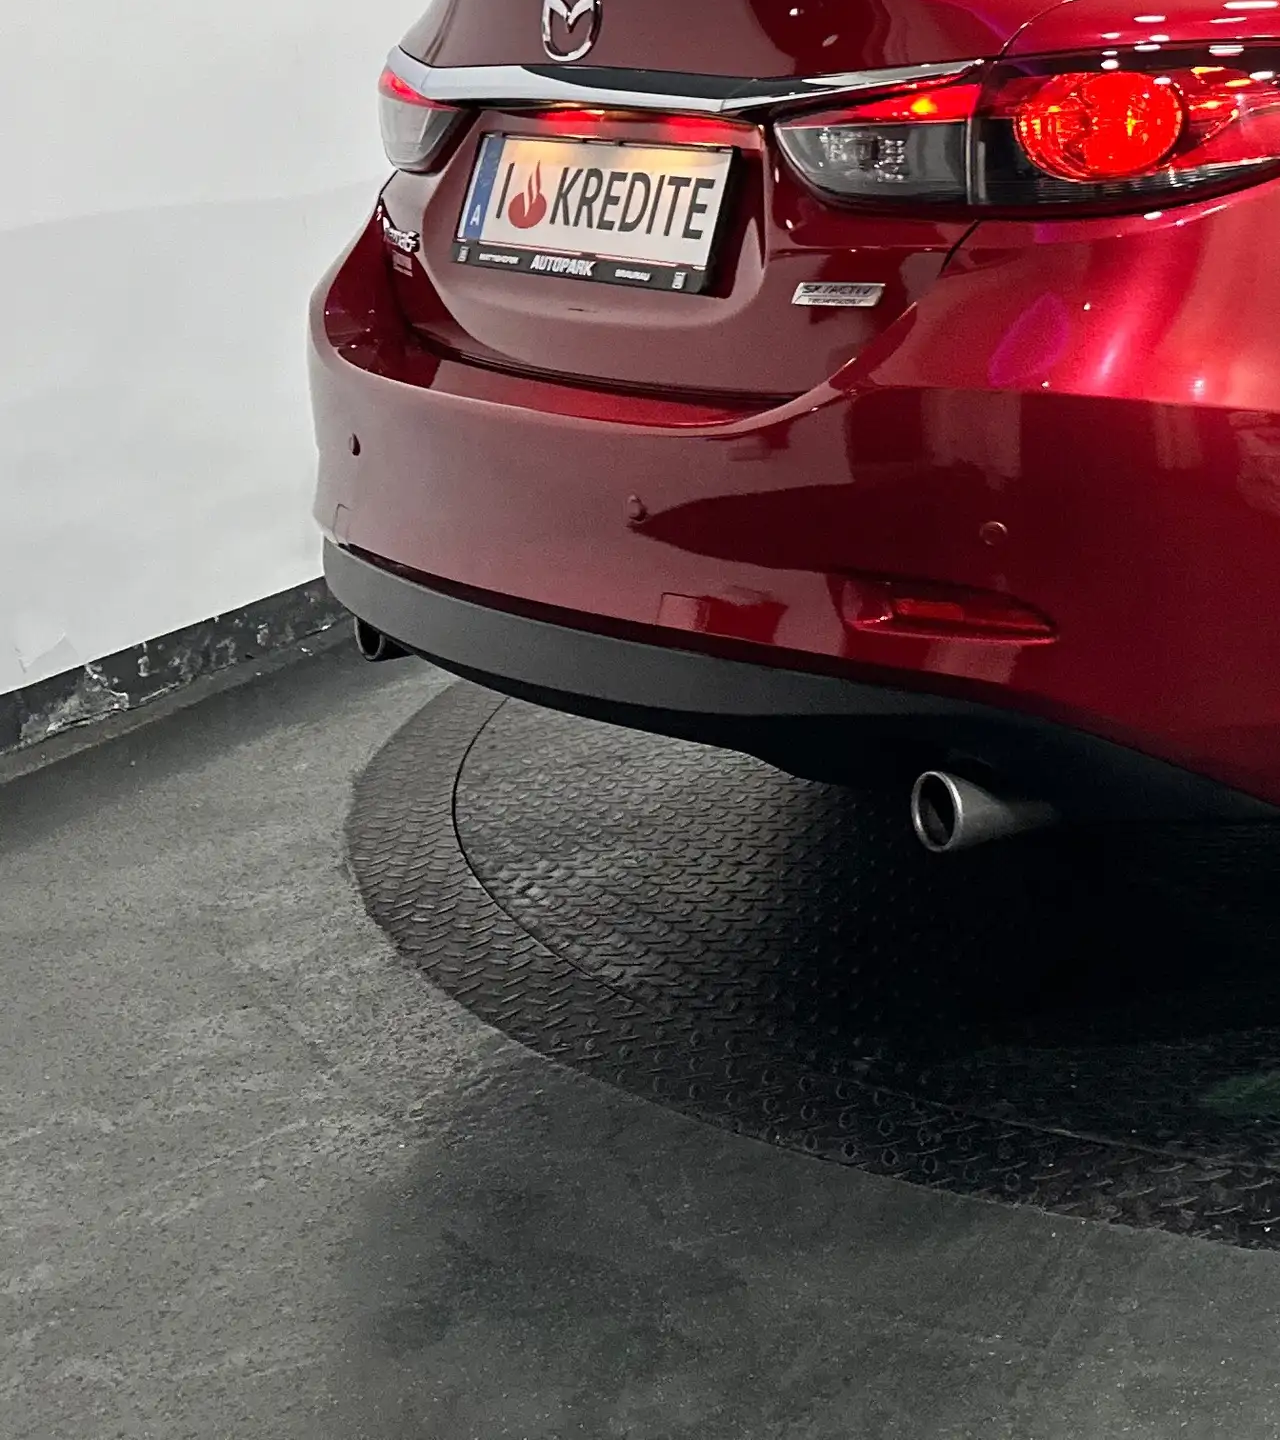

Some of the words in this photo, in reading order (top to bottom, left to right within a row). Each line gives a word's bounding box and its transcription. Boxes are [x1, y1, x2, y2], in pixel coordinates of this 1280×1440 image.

[549, 166, 716, 240] KREDITE
[469, 205, 480, 227] A
[530, 254, 596, 277] AUTOPARK
